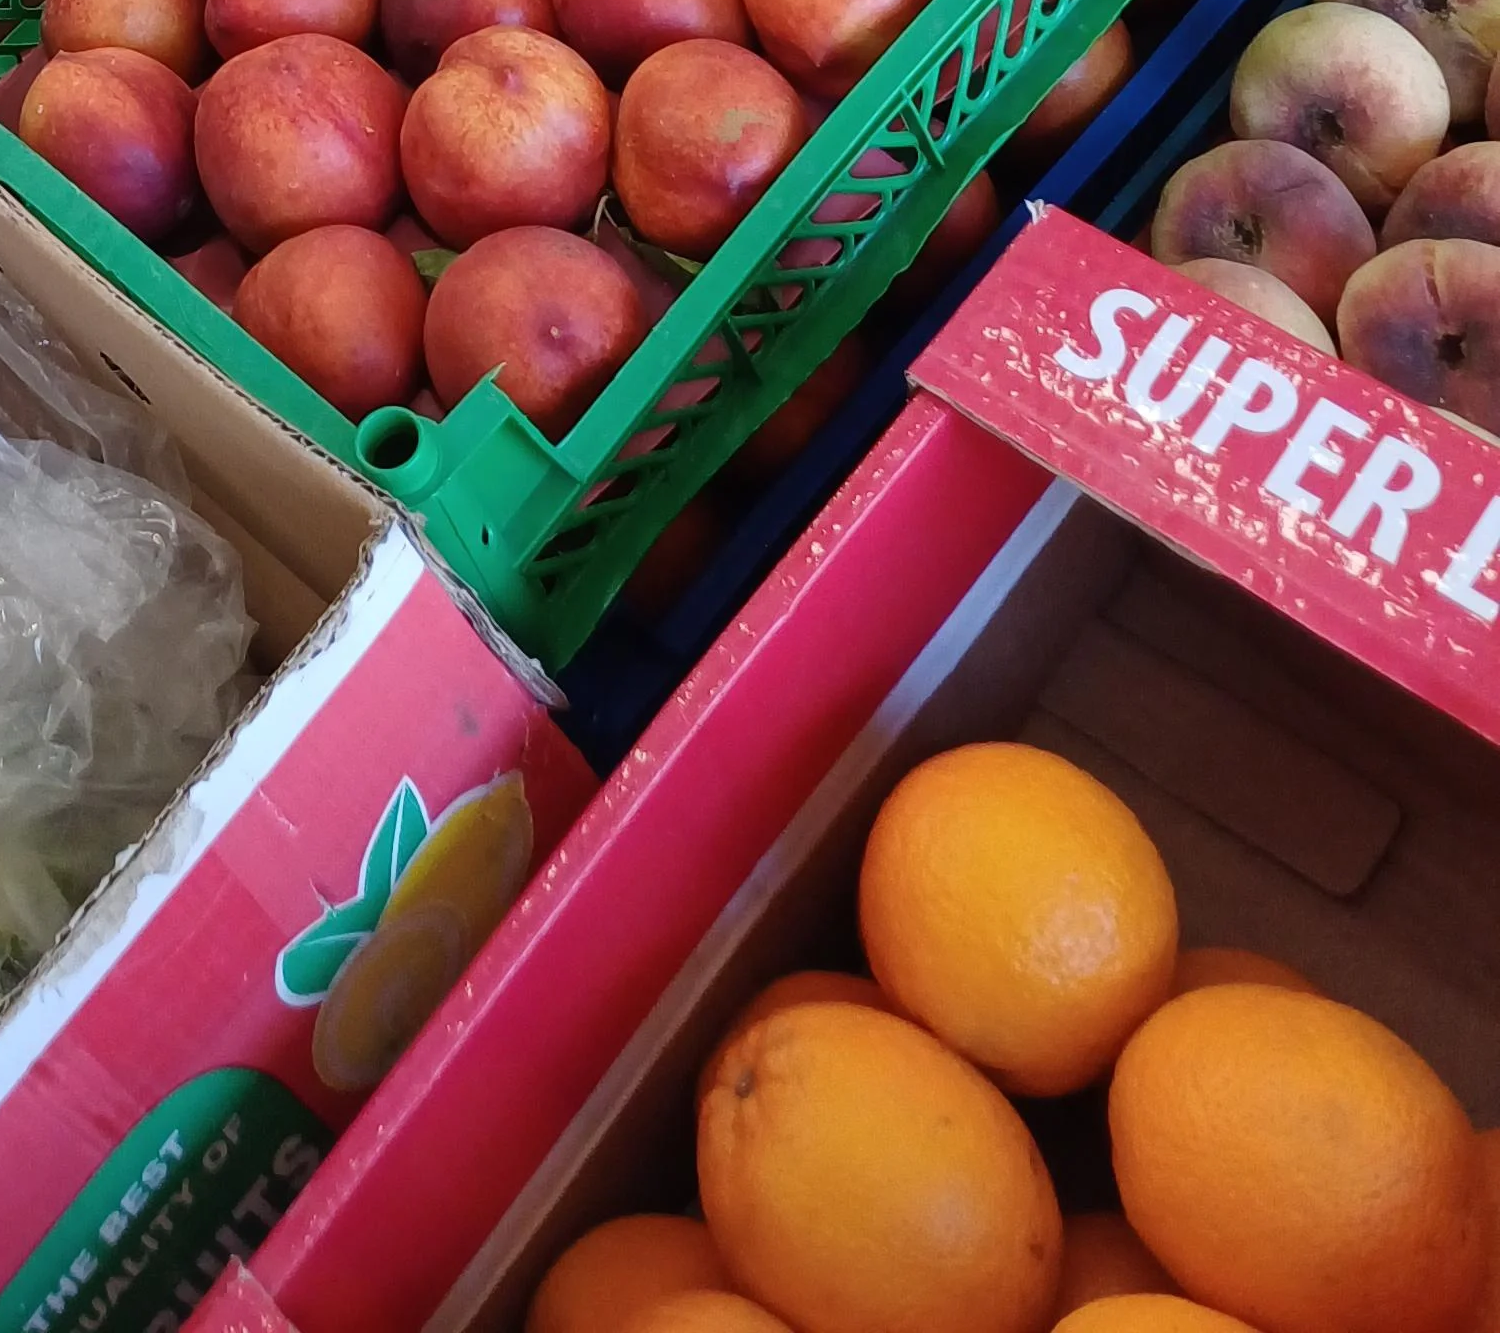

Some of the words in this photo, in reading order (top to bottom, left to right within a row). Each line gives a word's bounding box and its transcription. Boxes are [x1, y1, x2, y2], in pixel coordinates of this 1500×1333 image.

[1053, 288, 1442, 565] SUPER
[22, 1247, 99, 1333] THE
[100, 1129, 183, 1246] BEST
[71, 1177, 194, 1333] UALITY
[203, 1112, 242, 1175] OF
